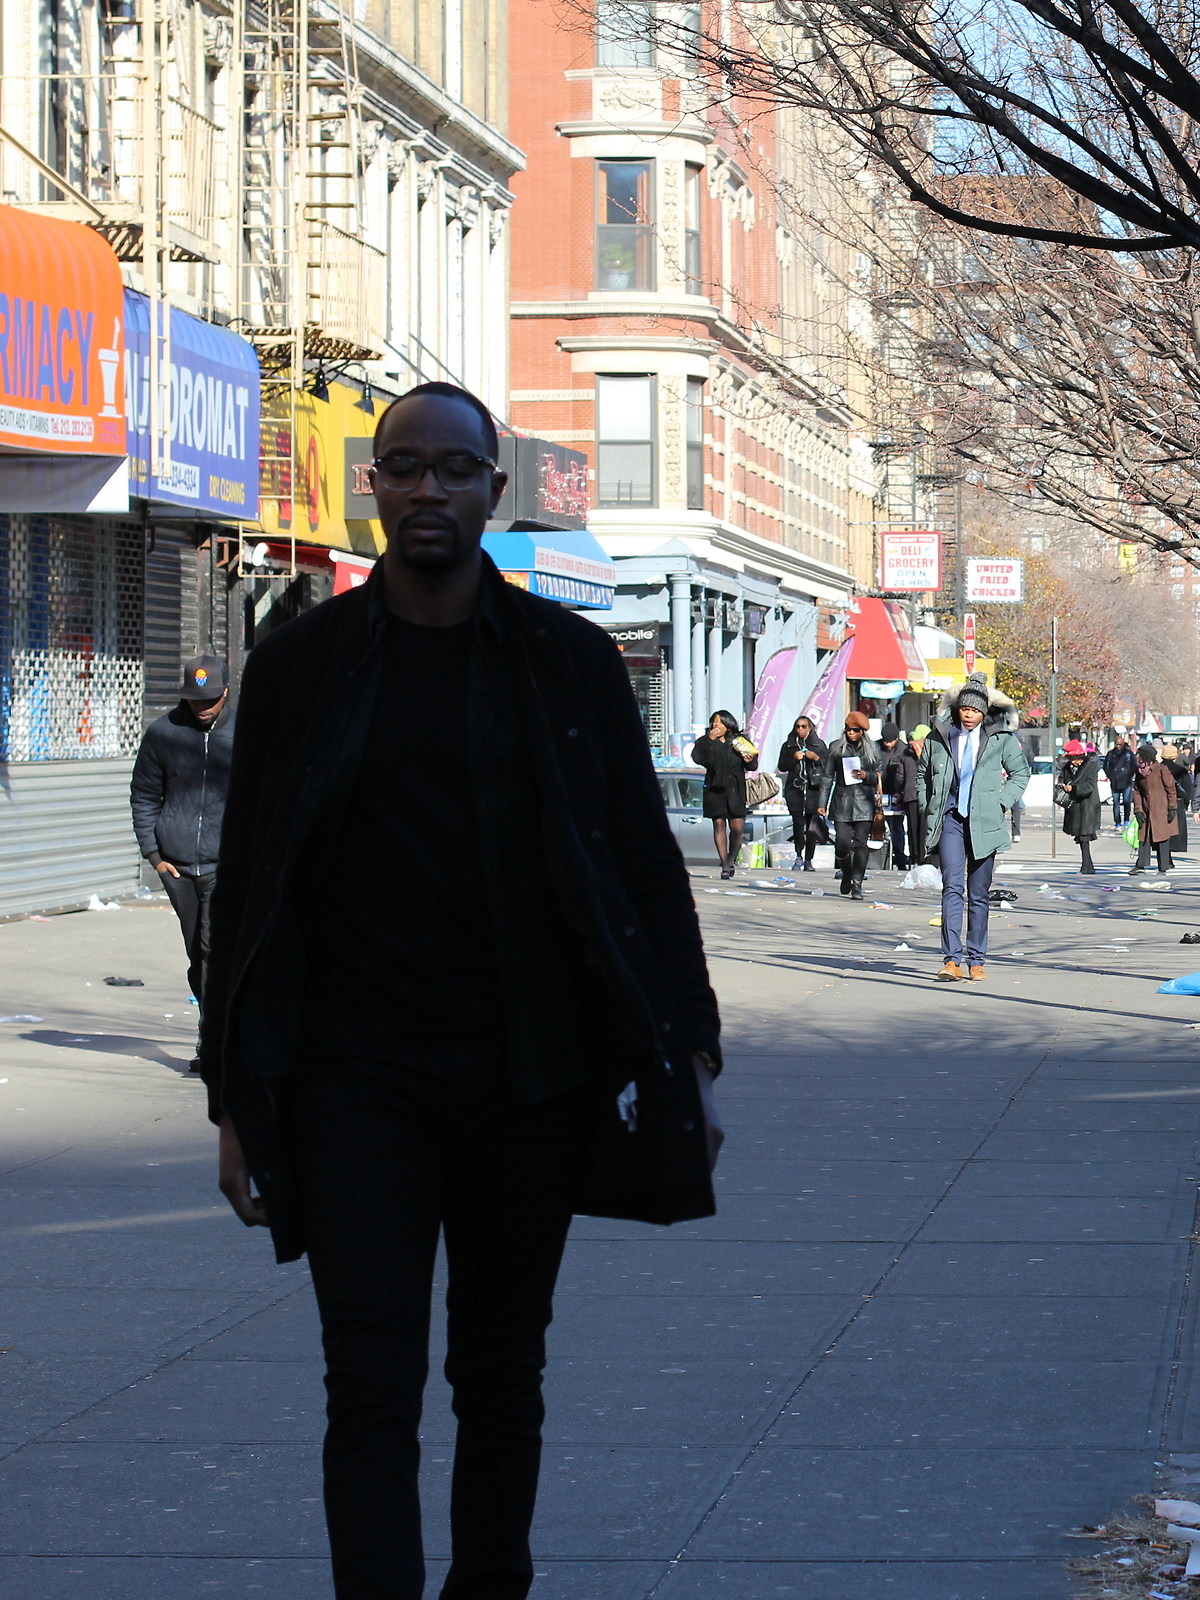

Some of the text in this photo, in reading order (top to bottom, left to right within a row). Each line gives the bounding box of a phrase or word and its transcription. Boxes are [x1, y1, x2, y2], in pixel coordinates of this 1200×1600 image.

[0, 292, 95, 406] RMACY
[124, 349, 249, 461] AUDROMAT
[901, 546, 921, 556] DELI
[889, 558, 934, 568] GROCERY
[897, 569, 926, 577] OPEN
[976, 565, 1013, 573] UNITED
[909, 579, 931, 587] HRS
[980, 576, 1009, 584] FRIED
[972, 588, 1016, 597] CHICKEN
